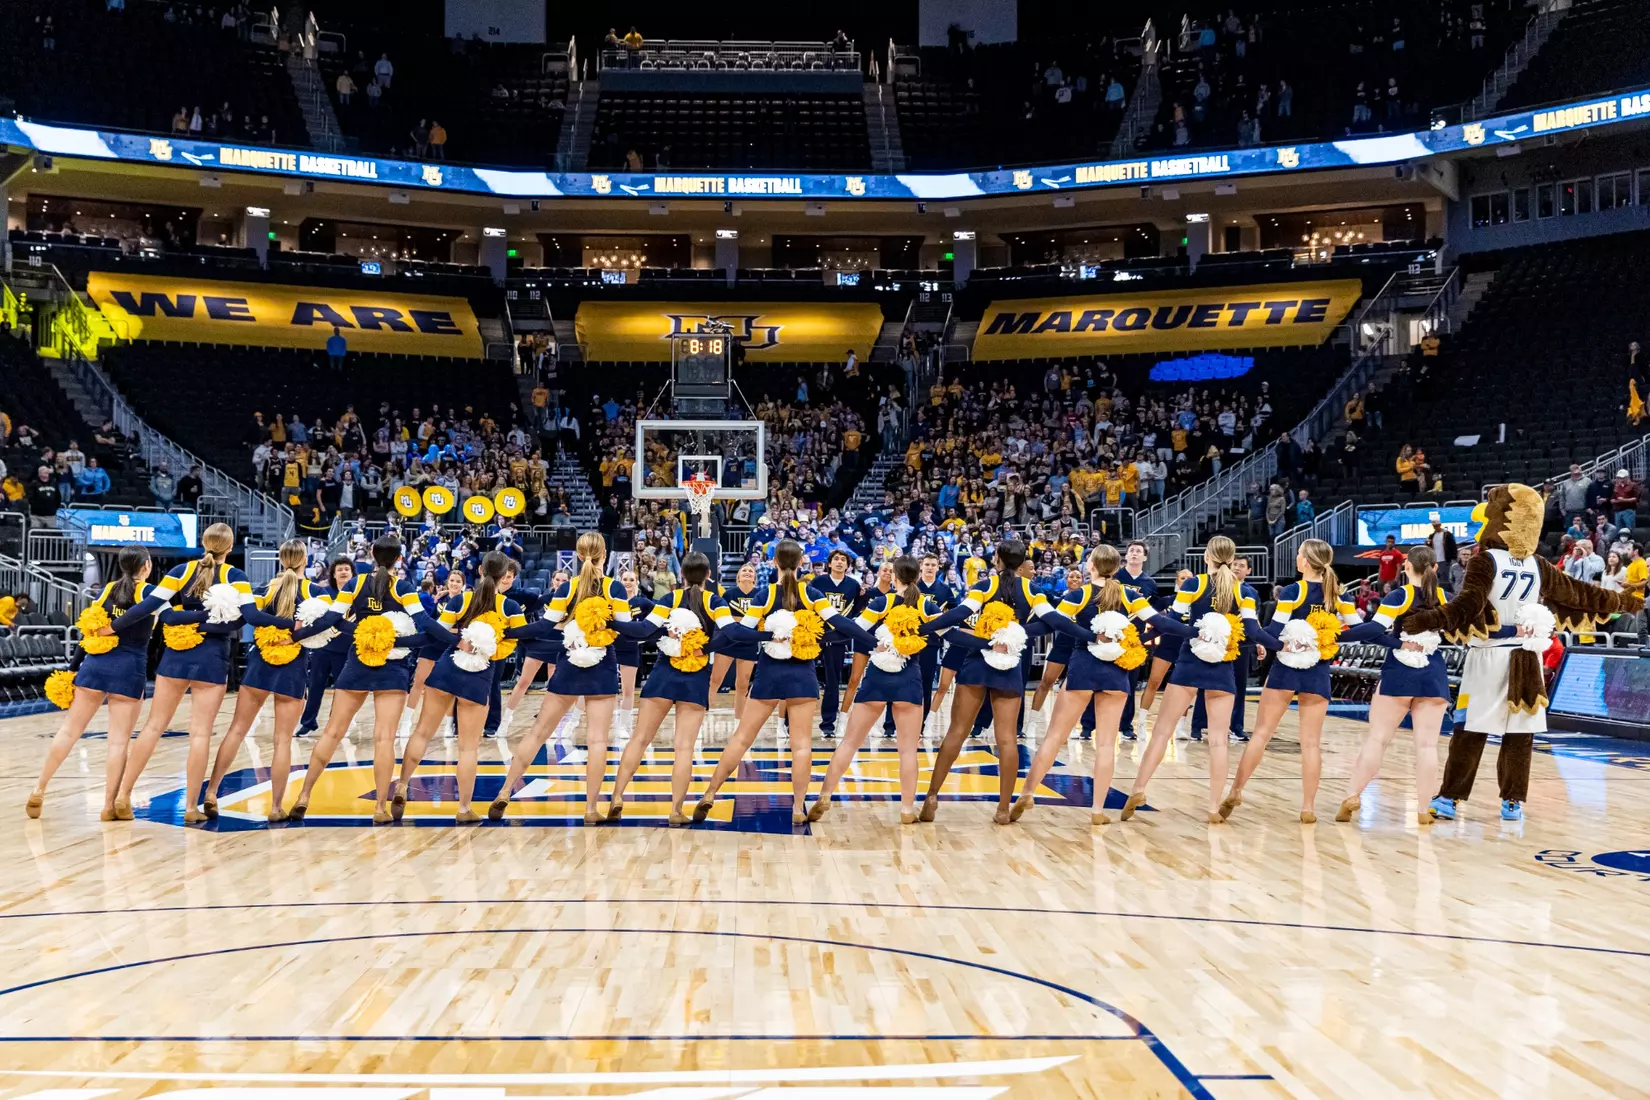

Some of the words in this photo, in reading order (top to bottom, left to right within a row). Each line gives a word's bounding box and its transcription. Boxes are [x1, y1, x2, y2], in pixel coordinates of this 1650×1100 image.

[1533, 100, 1617, 132] MARQUETTE
[1621, 94, 1650, 117] BAS
[220, 147, 296, 171] MARQUETTE
[299, 155, 378, 179] BASKETBALL
[1075, 162, 1148, 184] MARQUETTE
[1151, 155, 1230, 177] BASKETBALL
[654, 176, 725, 194] MARQUETTE
[728, 176, 803, 194] BASKETBALL
[506, 290, 518, 300] 110
[529, 290, 541, 300] 112
[919, 292, 931, 303] 112
[941, 292, 953, 303] 113
[110, 290, 257, 322] WE
[290, 301, 464, 336] ARE
[984, 298, 1331, 335] MARQUETTE
[690, 339, 722, 354] 8:18
[400, 494, 414, 509] MU
[430, 492, 444, 506] MU
[503, 495, 516, 509] MU
[471, 502, 485, 516] MU
[91, 525, 155, 542] MARQUETTE
[1499, 568, 1536, 602] 77
